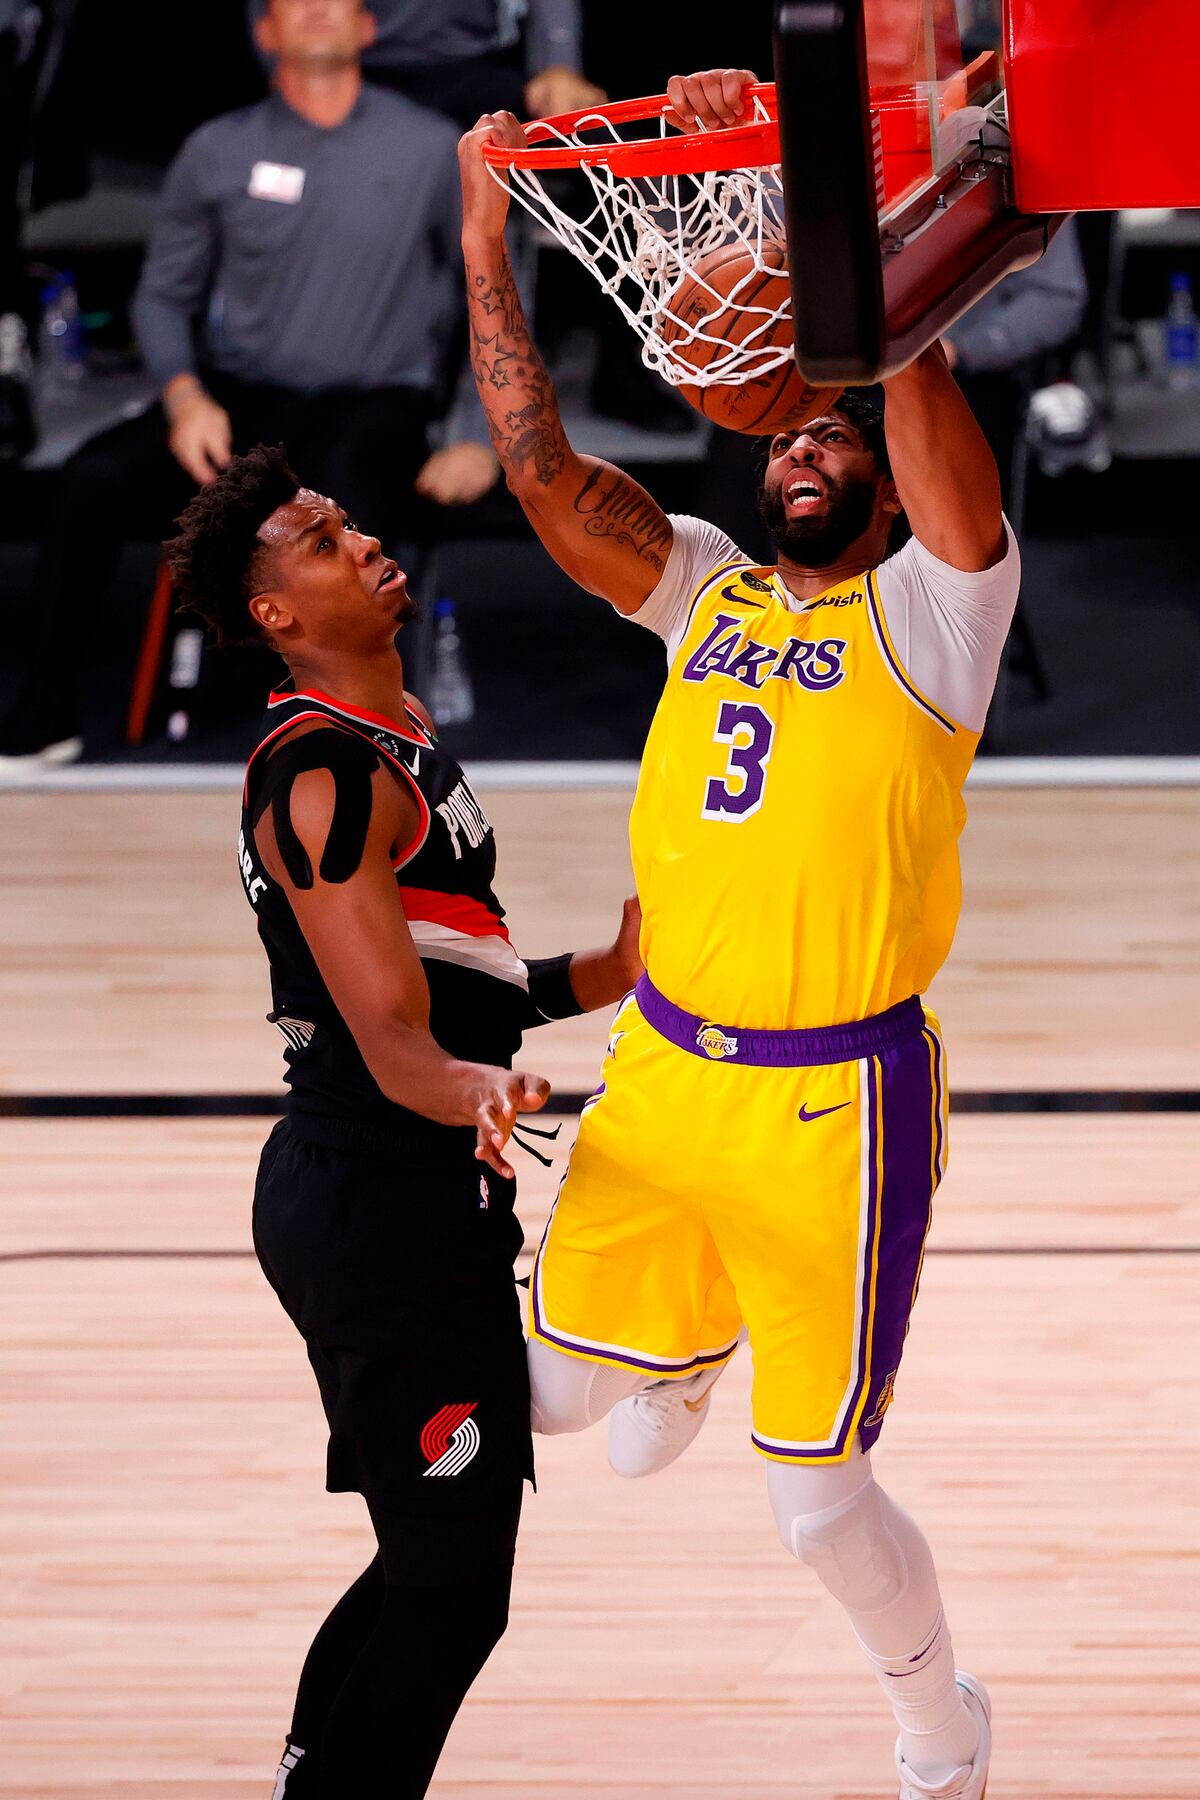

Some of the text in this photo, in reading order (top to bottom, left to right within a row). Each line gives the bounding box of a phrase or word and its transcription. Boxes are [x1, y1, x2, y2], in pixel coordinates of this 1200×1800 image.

[682, 613, 847, 692] LAKRS
[700, 699, 776, 824] 3
[699, 1034, 738, 1054] LAKERS
